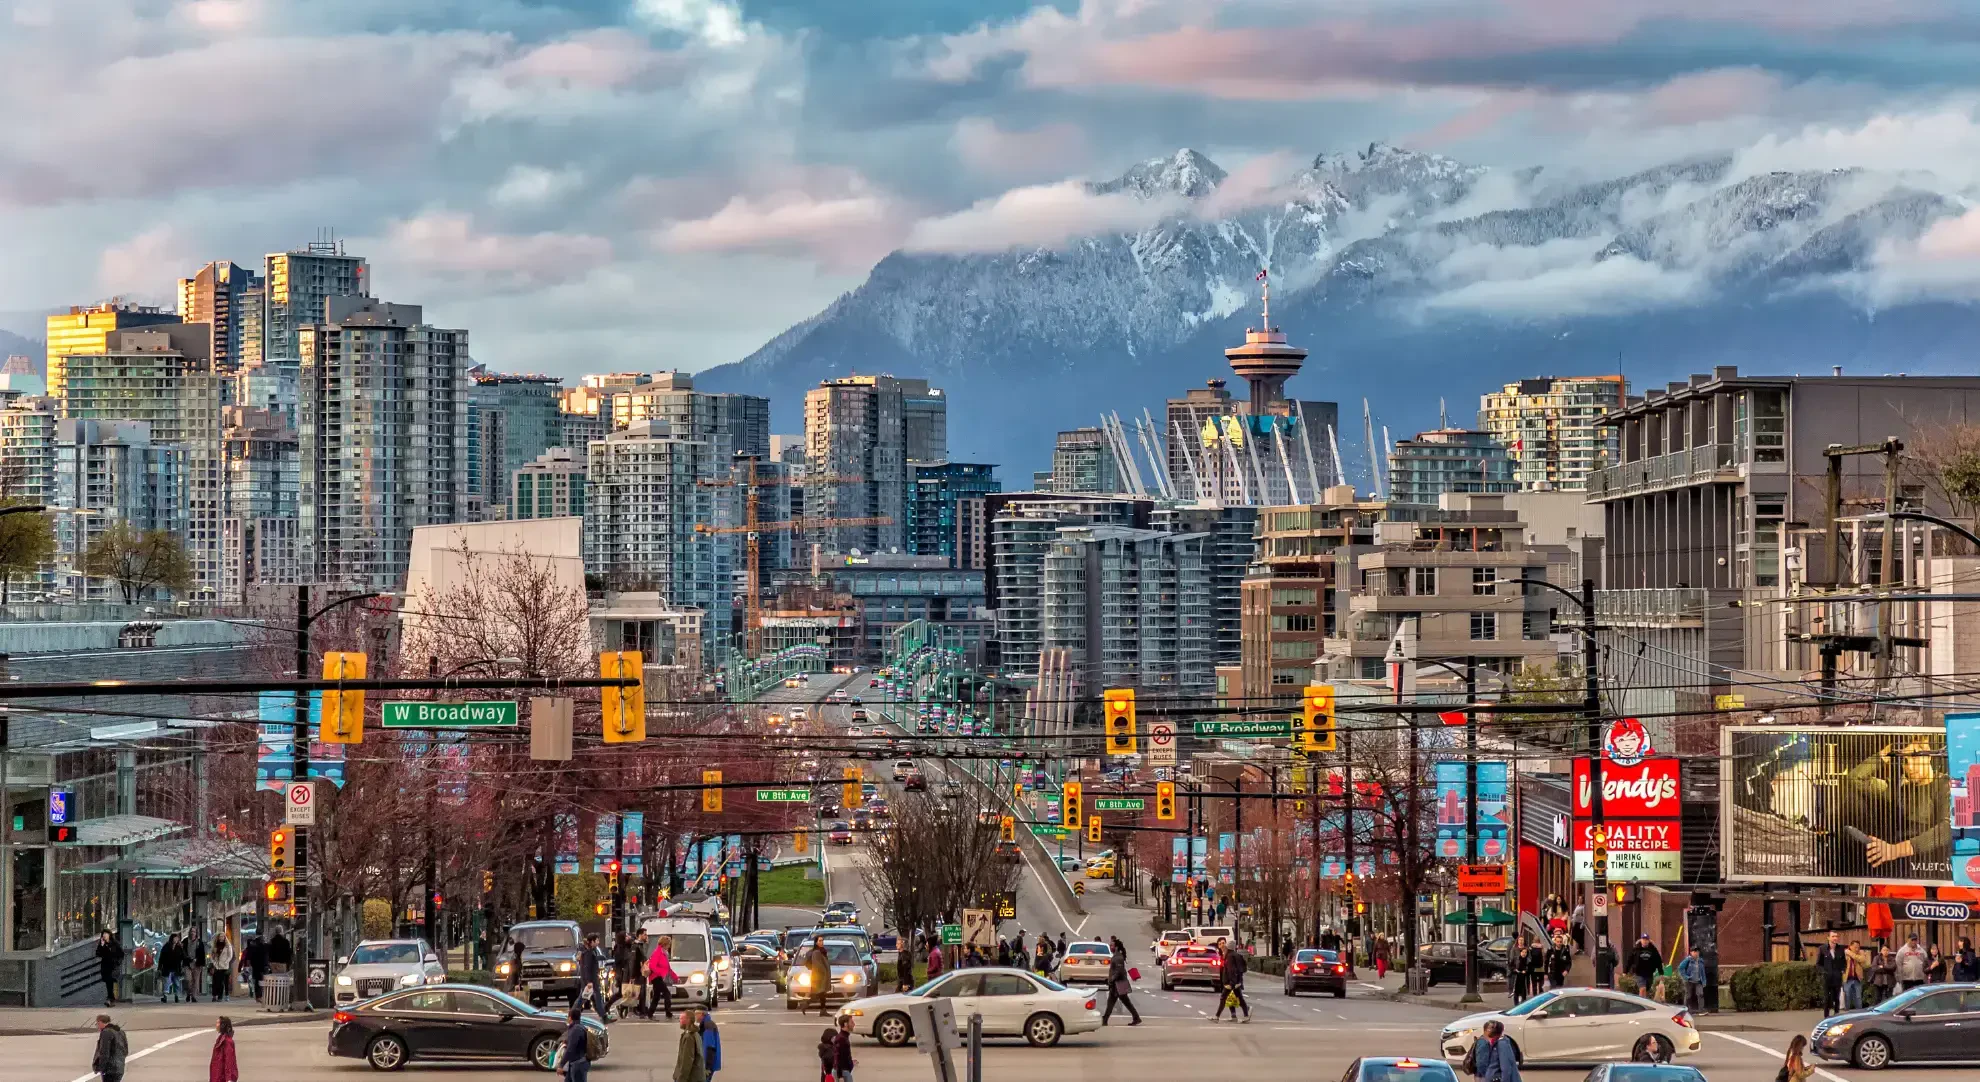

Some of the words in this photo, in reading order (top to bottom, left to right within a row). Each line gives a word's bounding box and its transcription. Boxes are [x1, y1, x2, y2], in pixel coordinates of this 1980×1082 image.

[395, 705, 410, 720] W
[420, 704, 506, 723] Broadway
[1202, 723, 1215, 733] W
[1220, 723, 1285, 735] Broadway
[760, 791, 769, 800] W
[772, 791, 787, 800] 8th
[790, 791, 806, 800] Ave
[1109, 800, 1123, 808] 8th
[1911, 905, 1965, 917] PATTISON
